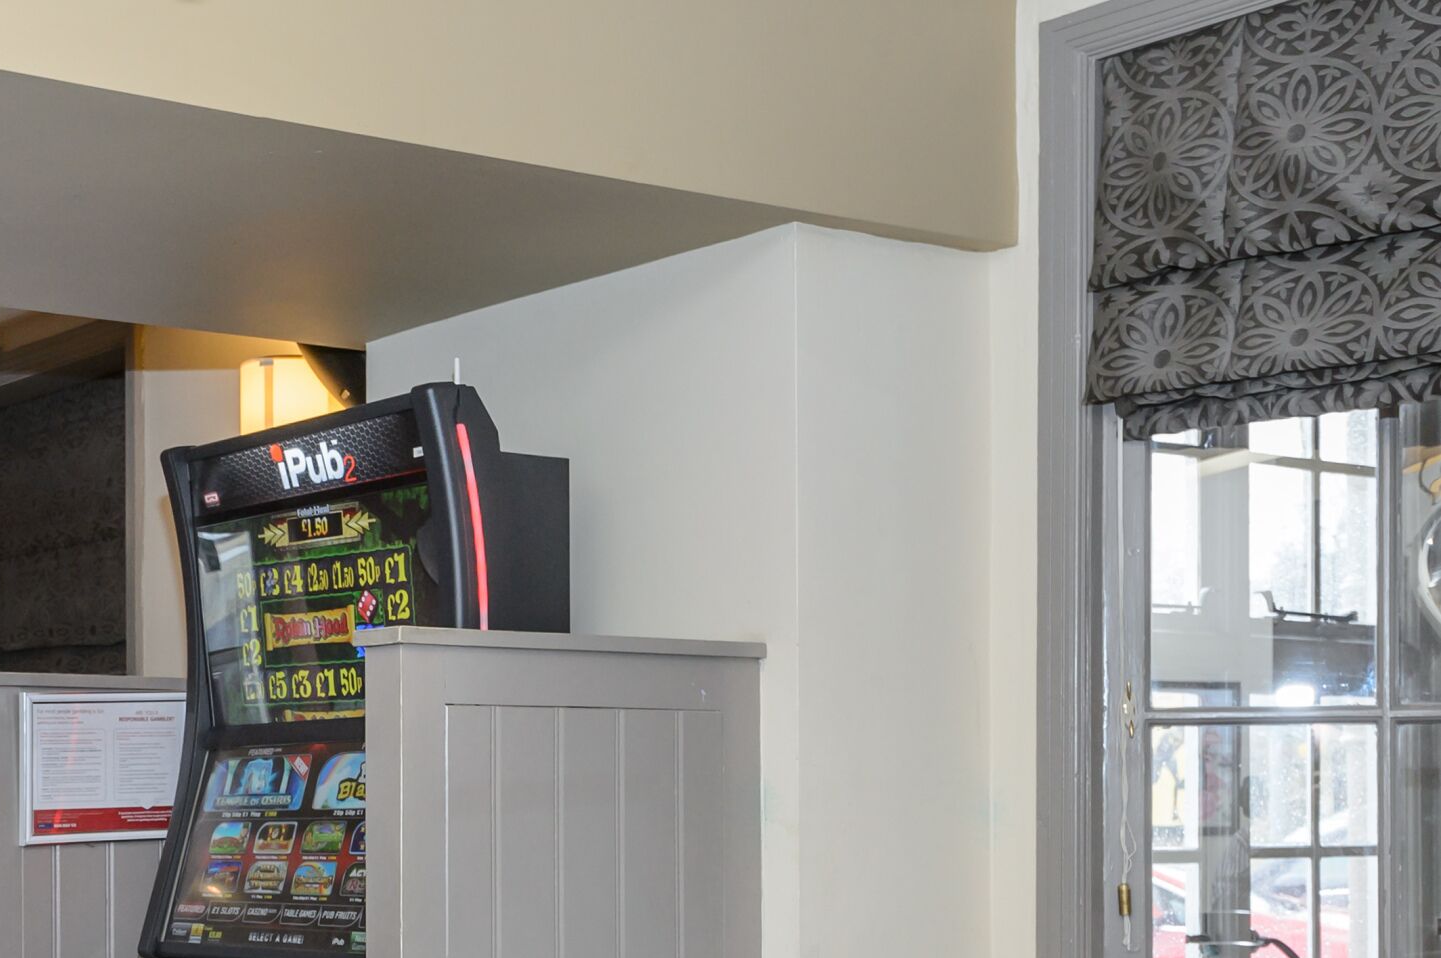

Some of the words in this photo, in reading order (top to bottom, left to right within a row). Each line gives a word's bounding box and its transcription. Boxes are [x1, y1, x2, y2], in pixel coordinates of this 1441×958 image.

[301, 516, 329, 538] £1.50
[284, 565, 304, 595] £4
[307, 562, 329, 592] £2.50
[332, 560, 355, 590] £1.50
[357, 555, 381, 588] 50p
[384, 552, 408, 585] £1
[239, 604, 259, 634] £1
[386, 588, 411, 622] £2
[312, 611, 350, 642] Hood
[242, 638, 263, 667] £2
[268, 670, 289, 700] £5
[291, 669, 312, 699] £3
[315, 667, 337, 698] £1
[339, 666, 363, 697] 50p
[261, 794, 292, 806] OSIRIS
[220, 906, 242, 916] SLOTS
[246, 907, 270, 917] CASINO
[283, 908, 300, 918] TABLE
[299, 909, 317, 919] GAMES
[321, 910, 335, 920] PUB
[334, 911, 358, 920] FRUITS
[247, 931, 274, 943] SELECT
[275, 934, 281, 943] A
